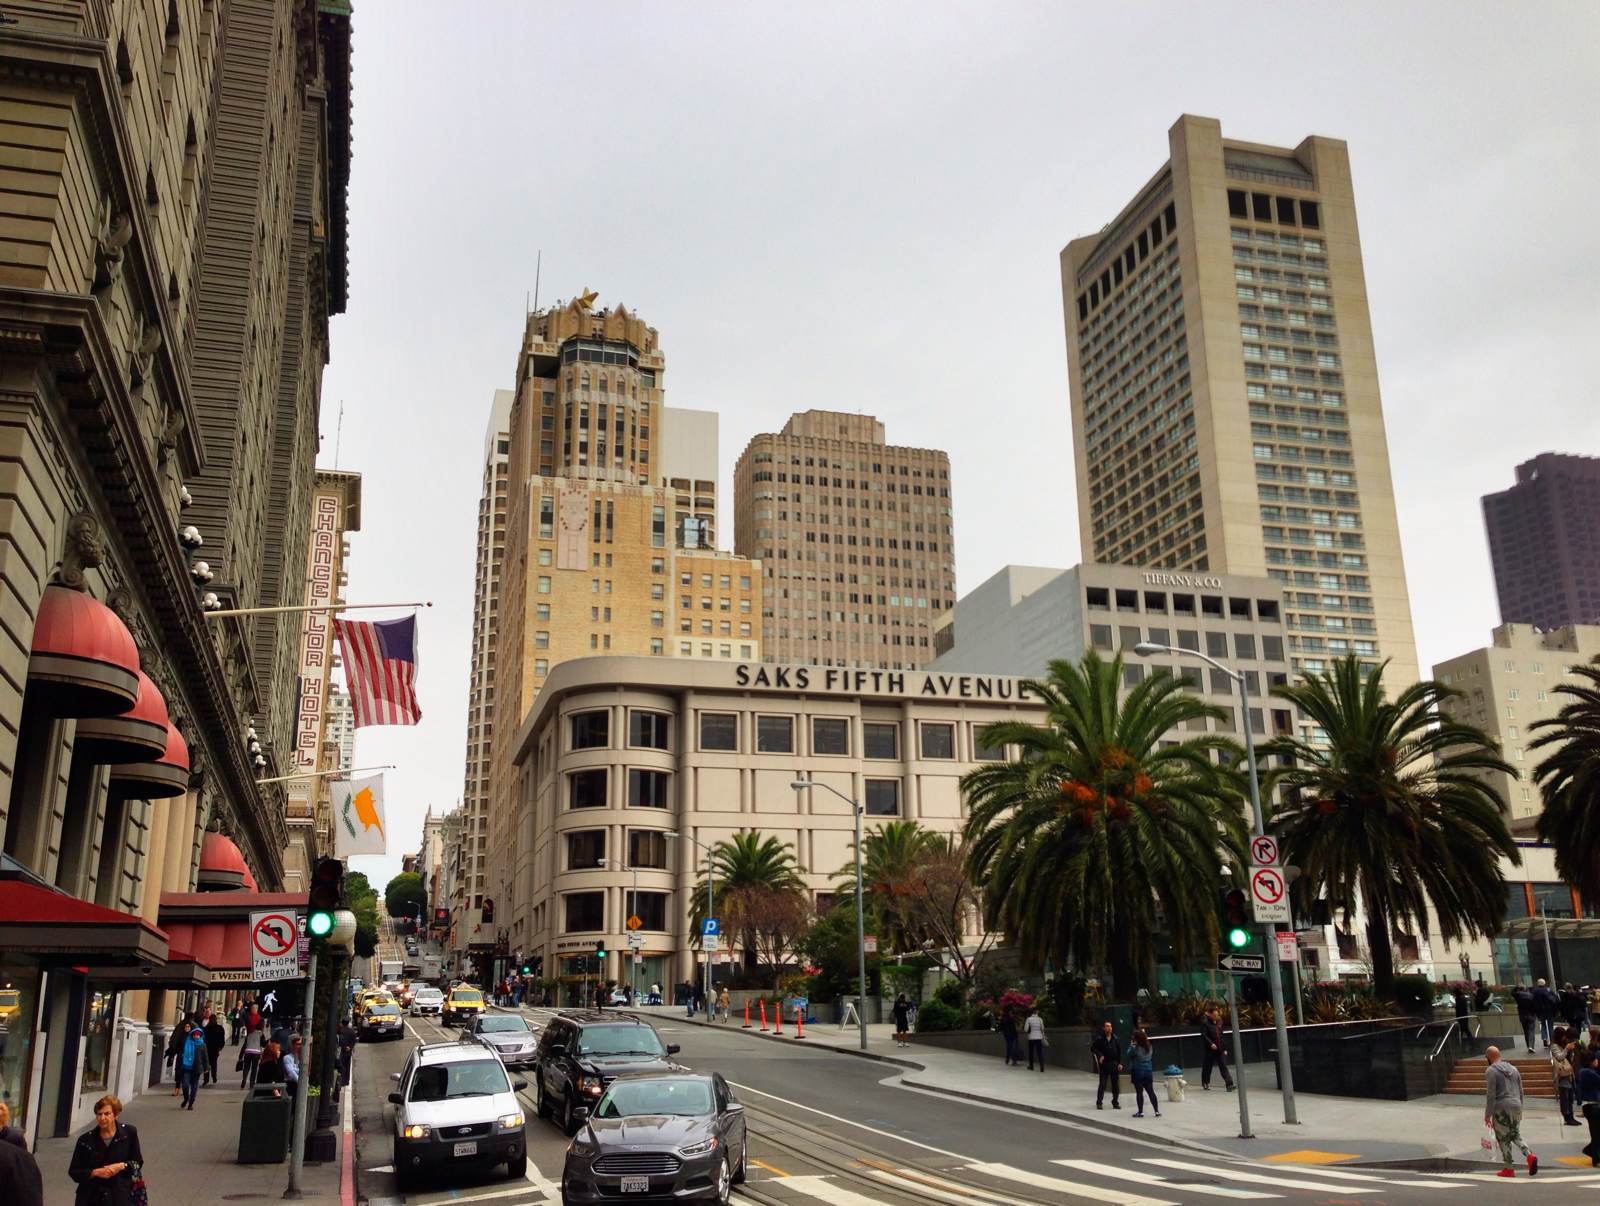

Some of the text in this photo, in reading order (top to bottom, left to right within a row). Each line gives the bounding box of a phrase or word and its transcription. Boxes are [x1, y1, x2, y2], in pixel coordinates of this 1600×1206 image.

[1143, 572, 1191, 587] TIFFANY
[1194, 576, 1203, 588] &
[297, 497, 337, 767] CHANCELLOR HOTEL
[736, 664, 1031, 700] SAKS FIFTH AVENUE
[1231, 959, 1260, 968] ONE WAY
[218, 972, 251, 980] WESTIN
[255, 968, 296, 979] EVERYDAY
